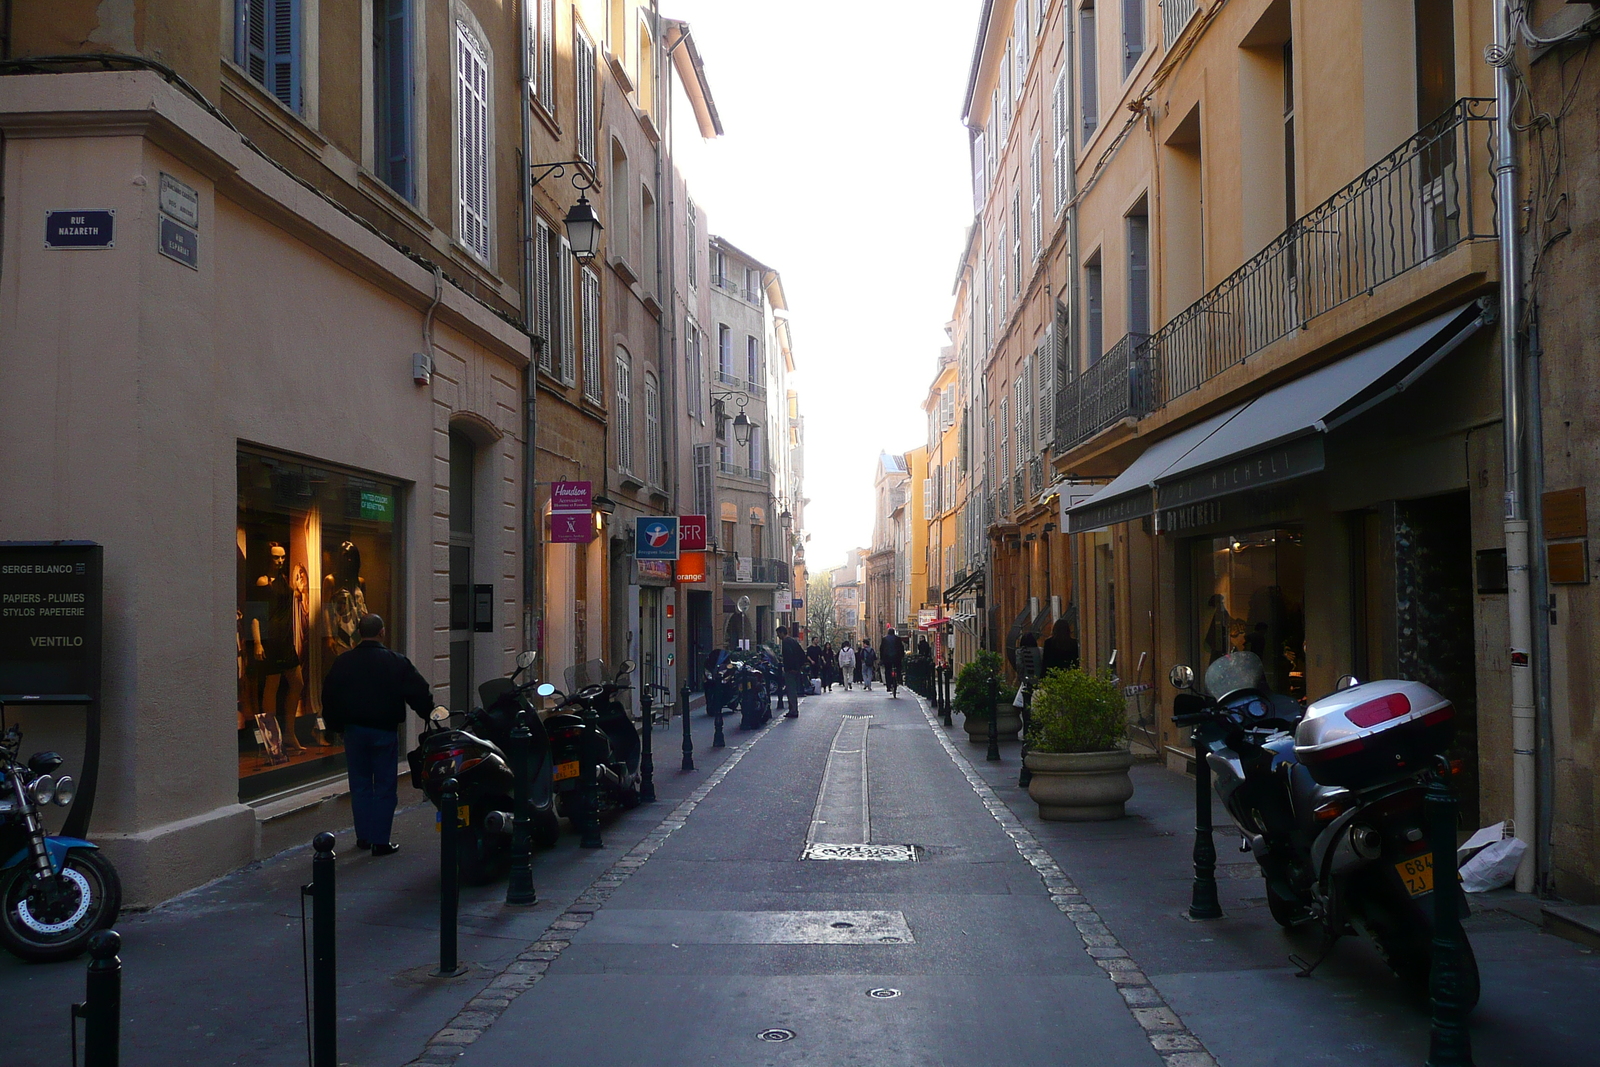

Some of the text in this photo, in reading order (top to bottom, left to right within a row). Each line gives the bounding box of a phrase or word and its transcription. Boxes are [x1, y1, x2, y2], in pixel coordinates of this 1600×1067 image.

[70, 216, 86, 225] RUE
[58, 227, 99, 236] NAZARETH
[175, 233, 184, 244] RUE
[1178, 452, 1290, 499] DI MICHELI
[555, 484, 587, 496] Handson
[2, 565, 33, 574] SERGE
[35, 565, 73, 574] BLANCO
[3, 593, 41, 603] PAPIERS
[48, 593, 85, 603] PLUMES
[2, 607, 85, 617] STYLOS PAPETERIE
[30, 636, 83, 647] VENTILO
[1405, 856, 1434, 875] 684
